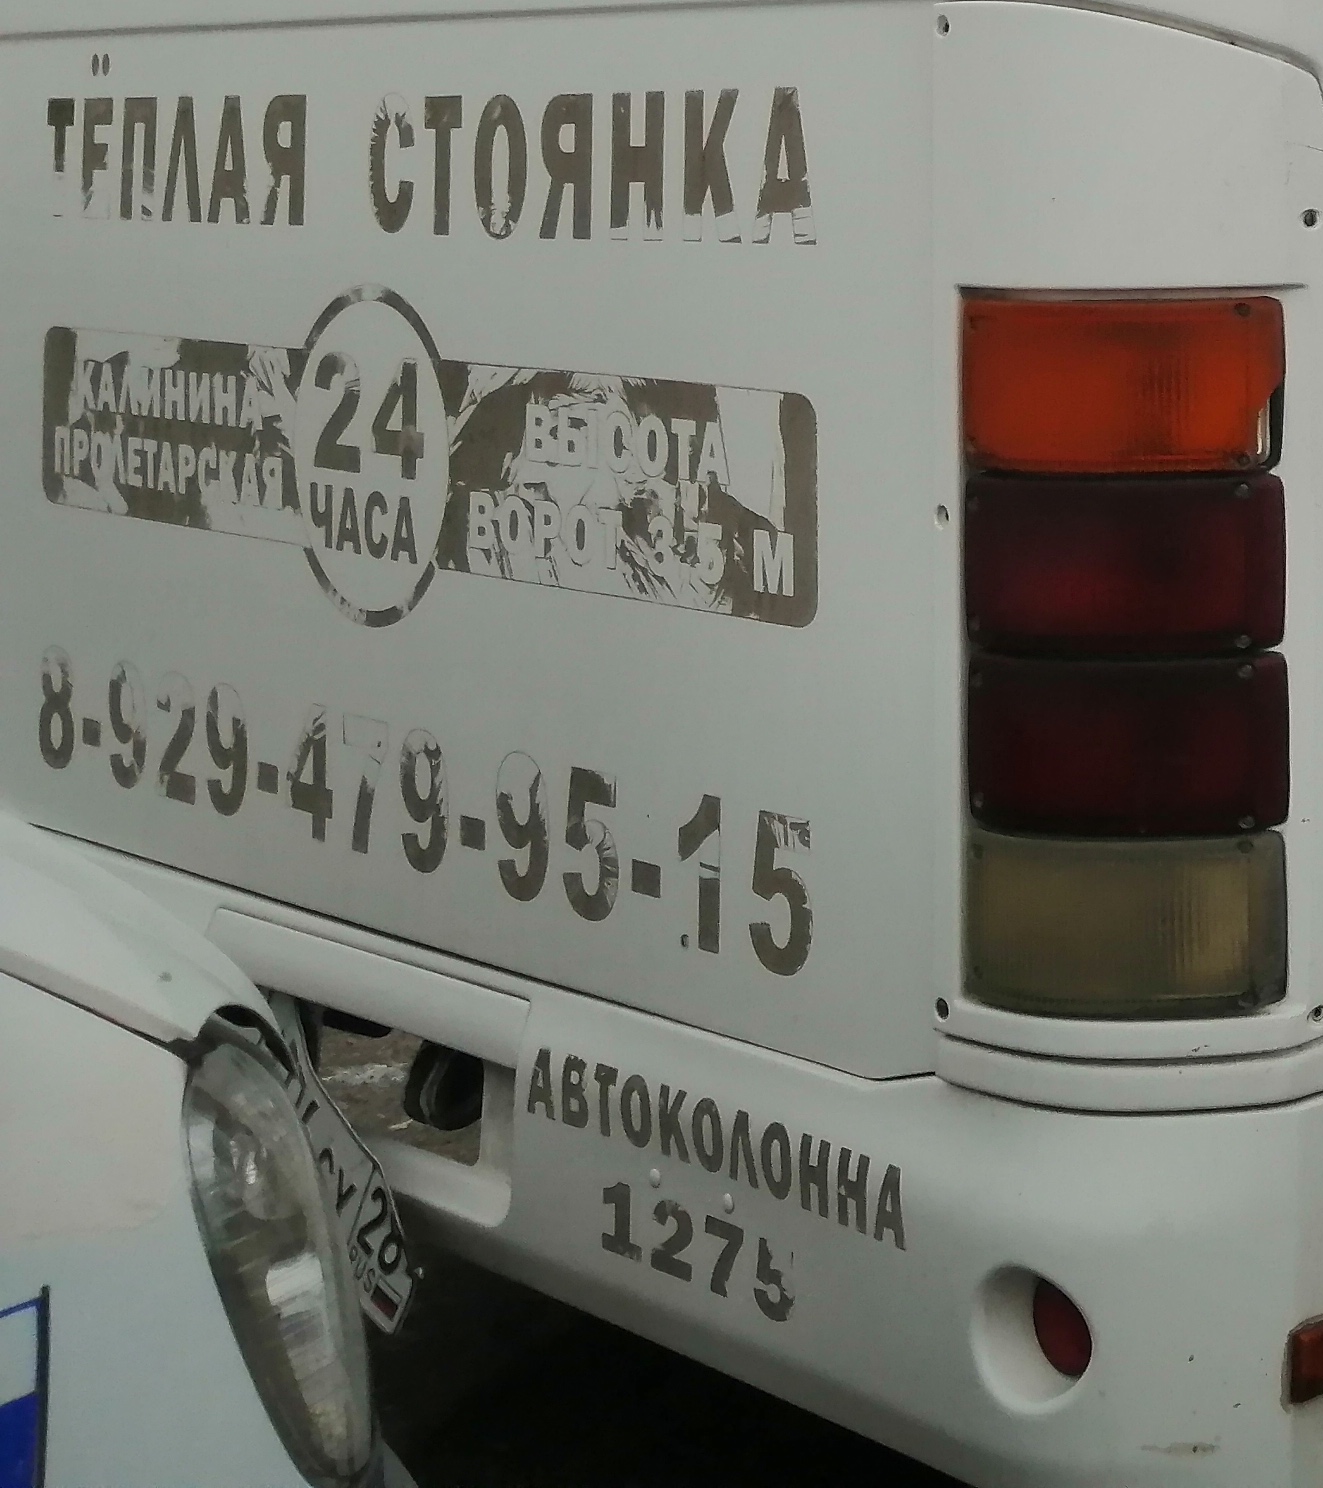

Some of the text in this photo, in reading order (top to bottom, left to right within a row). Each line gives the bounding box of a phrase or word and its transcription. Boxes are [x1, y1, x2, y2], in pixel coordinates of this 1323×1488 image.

[46, 53, 817, 245] ТЁПЛАЯ СТОЯНКА
[76, 361, 263, 431] КАЛИНИНА
[314, 351, 425, 480] 24
[310, 481, 418, 564] ЧАСА
[753, 529, 795, 598] М
[37, 644, 814, 977] 8-929-479-95-15
[527, 1046, 906, 1250] АВТОКОЛОННА
[601, 1181, 796, 1322] 1275
